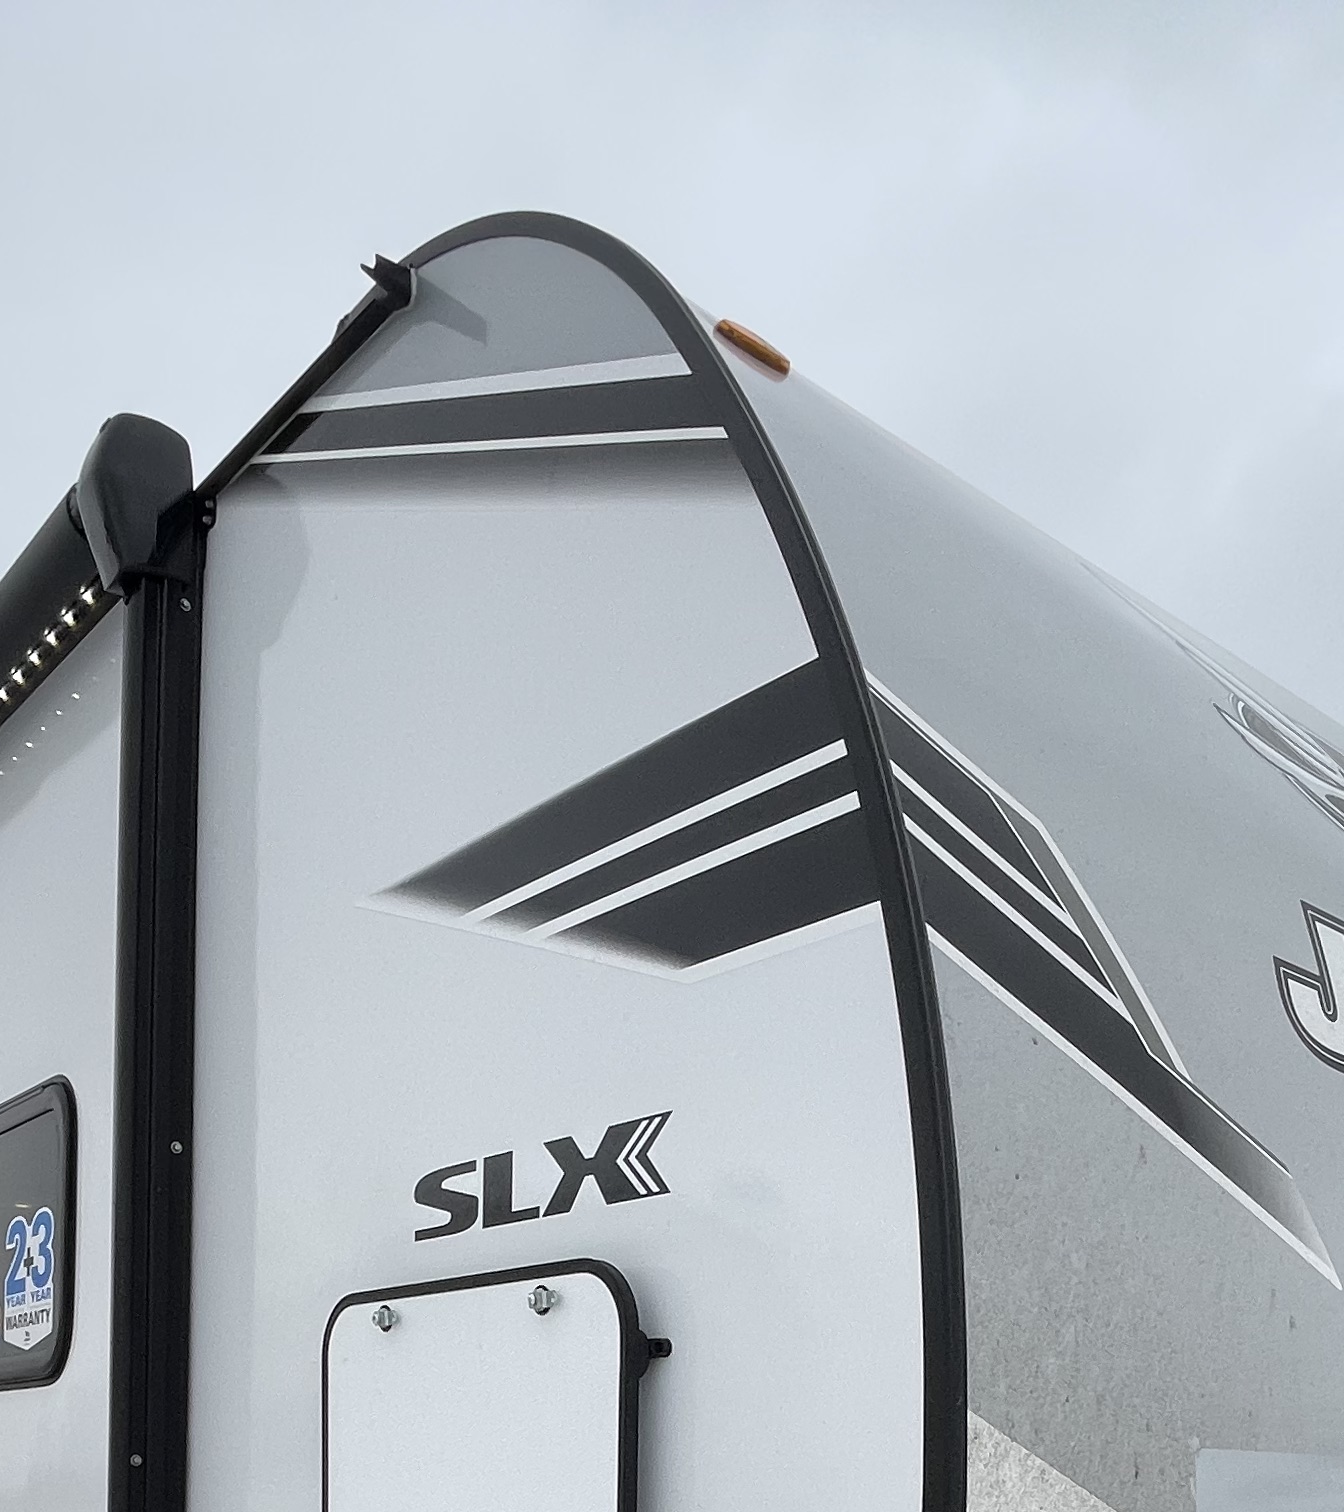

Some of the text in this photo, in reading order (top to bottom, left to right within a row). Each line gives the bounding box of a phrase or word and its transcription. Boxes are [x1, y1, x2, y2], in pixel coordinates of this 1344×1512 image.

[413, 1109, 673, 1242] SLX
[6, 1287, 51, 1308] YEAR YEAR
[6, 1308, 51, 1330] WARRANTY
